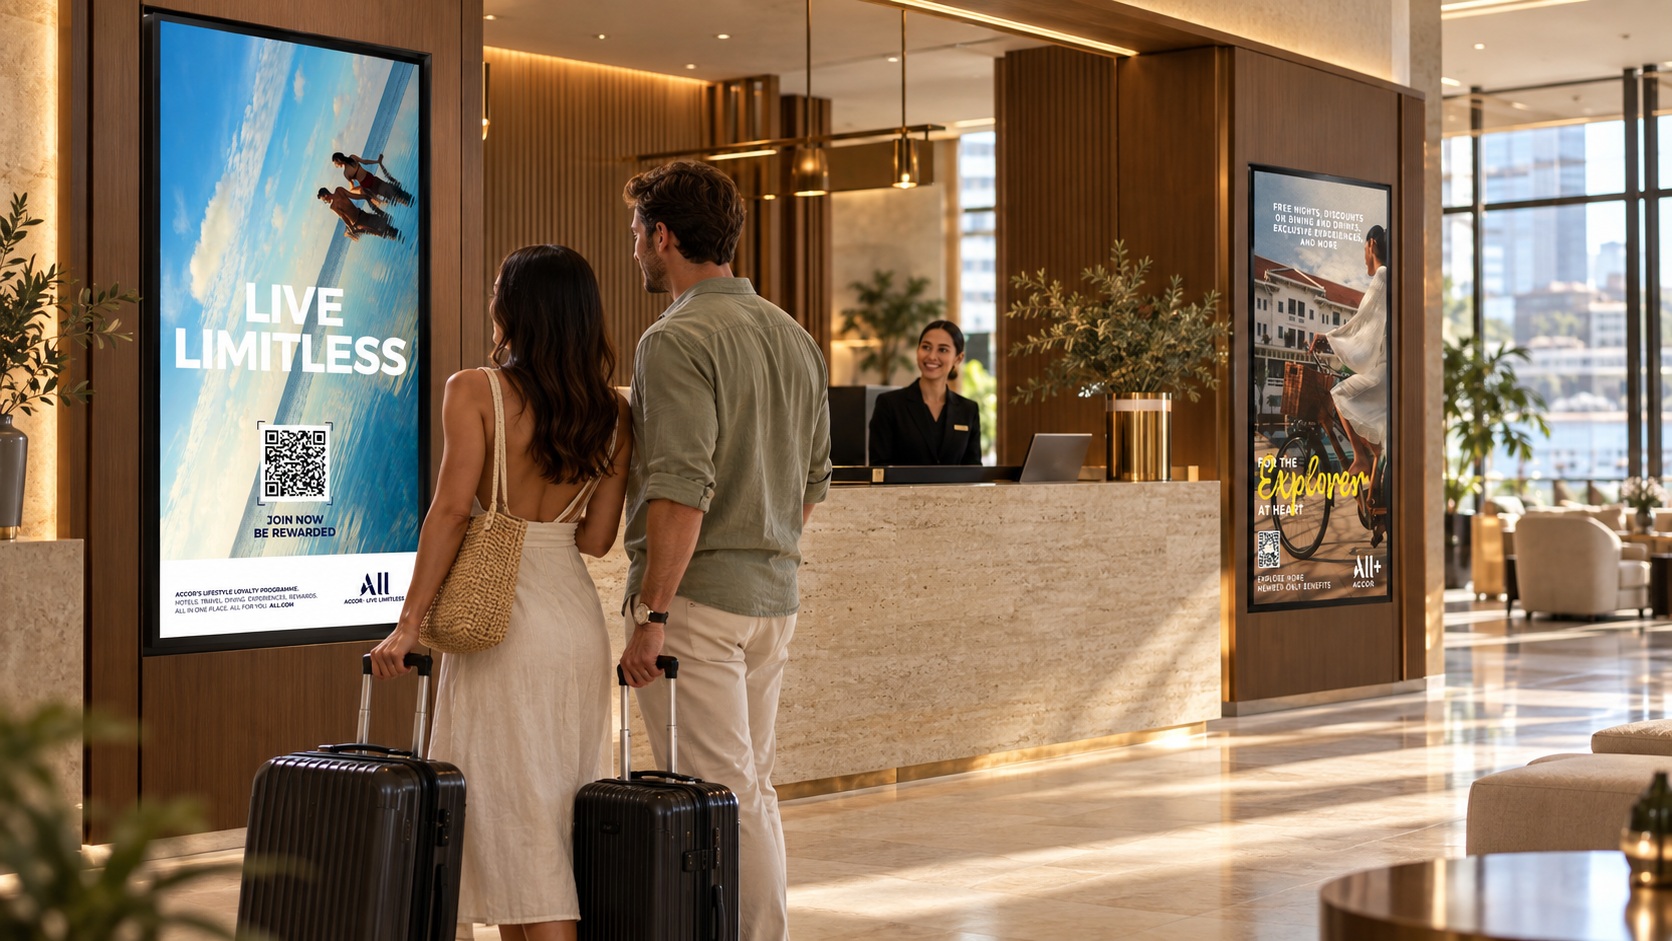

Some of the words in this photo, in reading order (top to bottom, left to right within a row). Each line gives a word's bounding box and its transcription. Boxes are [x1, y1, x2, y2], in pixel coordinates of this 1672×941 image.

[1273, 202, 1292, 213] FREE
[1324, 209, 1364, 223] DISCOUNTS
[1316, 218, 1331, 228] AND
[1273, 223, 1312, 237] EXCLUSIVE
[1300, 238, 1316, 247] AND
[245, 282, 344, 328] LIVE
[175, 327, 407, 376] LIMITLESS
[1257, 457, 1277, 468] FOR
[1279, 457, 1298, 468] THE
[1257, 454, 1370, 517] Explorer
[1257, 504, 1271, 516] AT
[1272, 504, 1304, 516] HEART
[266, 515, 293, 525] JOIN
[295, 514, 324, 525] NOW
[253, 528, 269, 538] BE
[271, 527, 337, 538] REWARDED
[1352, 580, 1375, 588] ACCOR
[174, 590, 202, 598] ACCOR'S
[202, 588, 233, 597] LIFESTYLE
[233, 587, 260, 596] LOYALTY
[378, 595, 405, 603] LIMITLESS
[174, 607, 186, 615] ALL
[269, 601, 295, 609] ALL.COM
